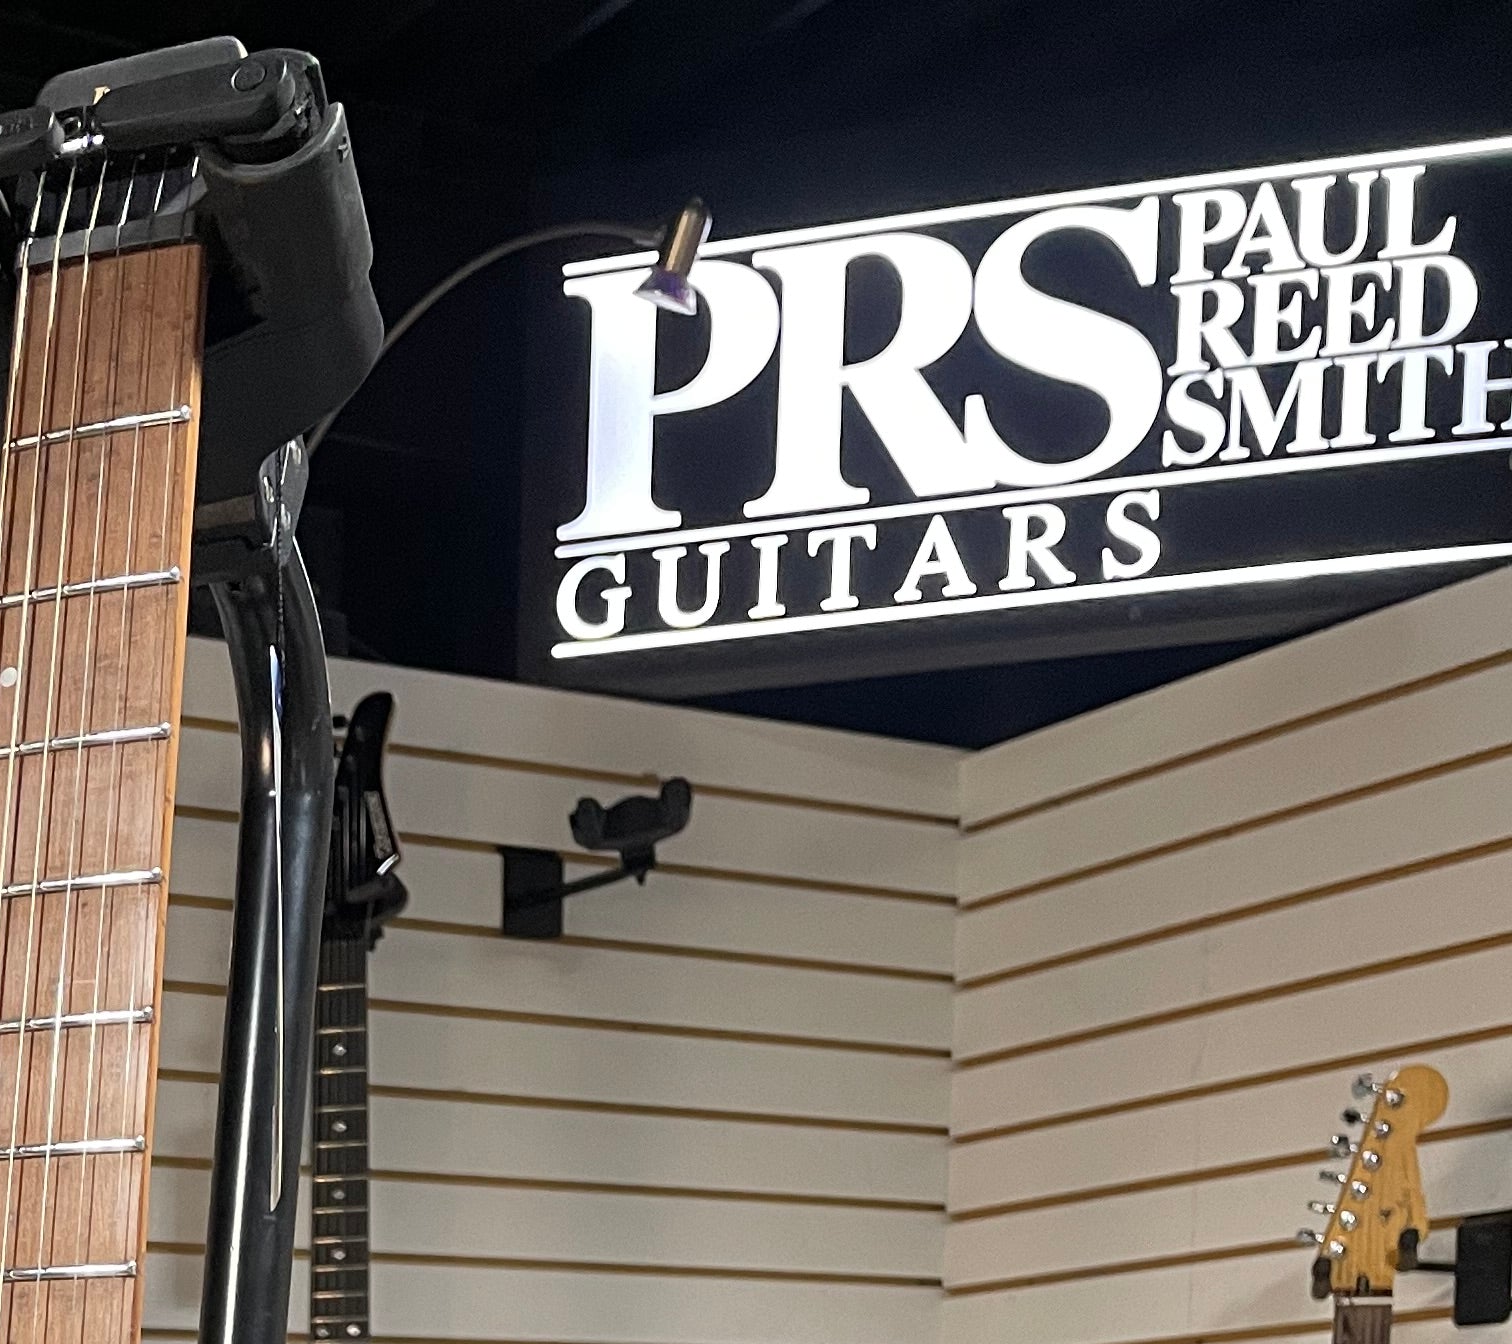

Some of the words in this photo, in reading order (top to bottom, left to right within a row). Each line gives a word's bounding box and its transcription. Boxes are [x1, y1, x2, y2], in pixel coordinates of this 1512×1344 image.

[1170, 165, 1458, 286] PAUL
[556, 197, 1164, 542] PRS
[1170, 253, 1480, 378] REED
[1161, 339, 1512, 469] SMITH
[556, 488, 1163, 640] GUITARS
